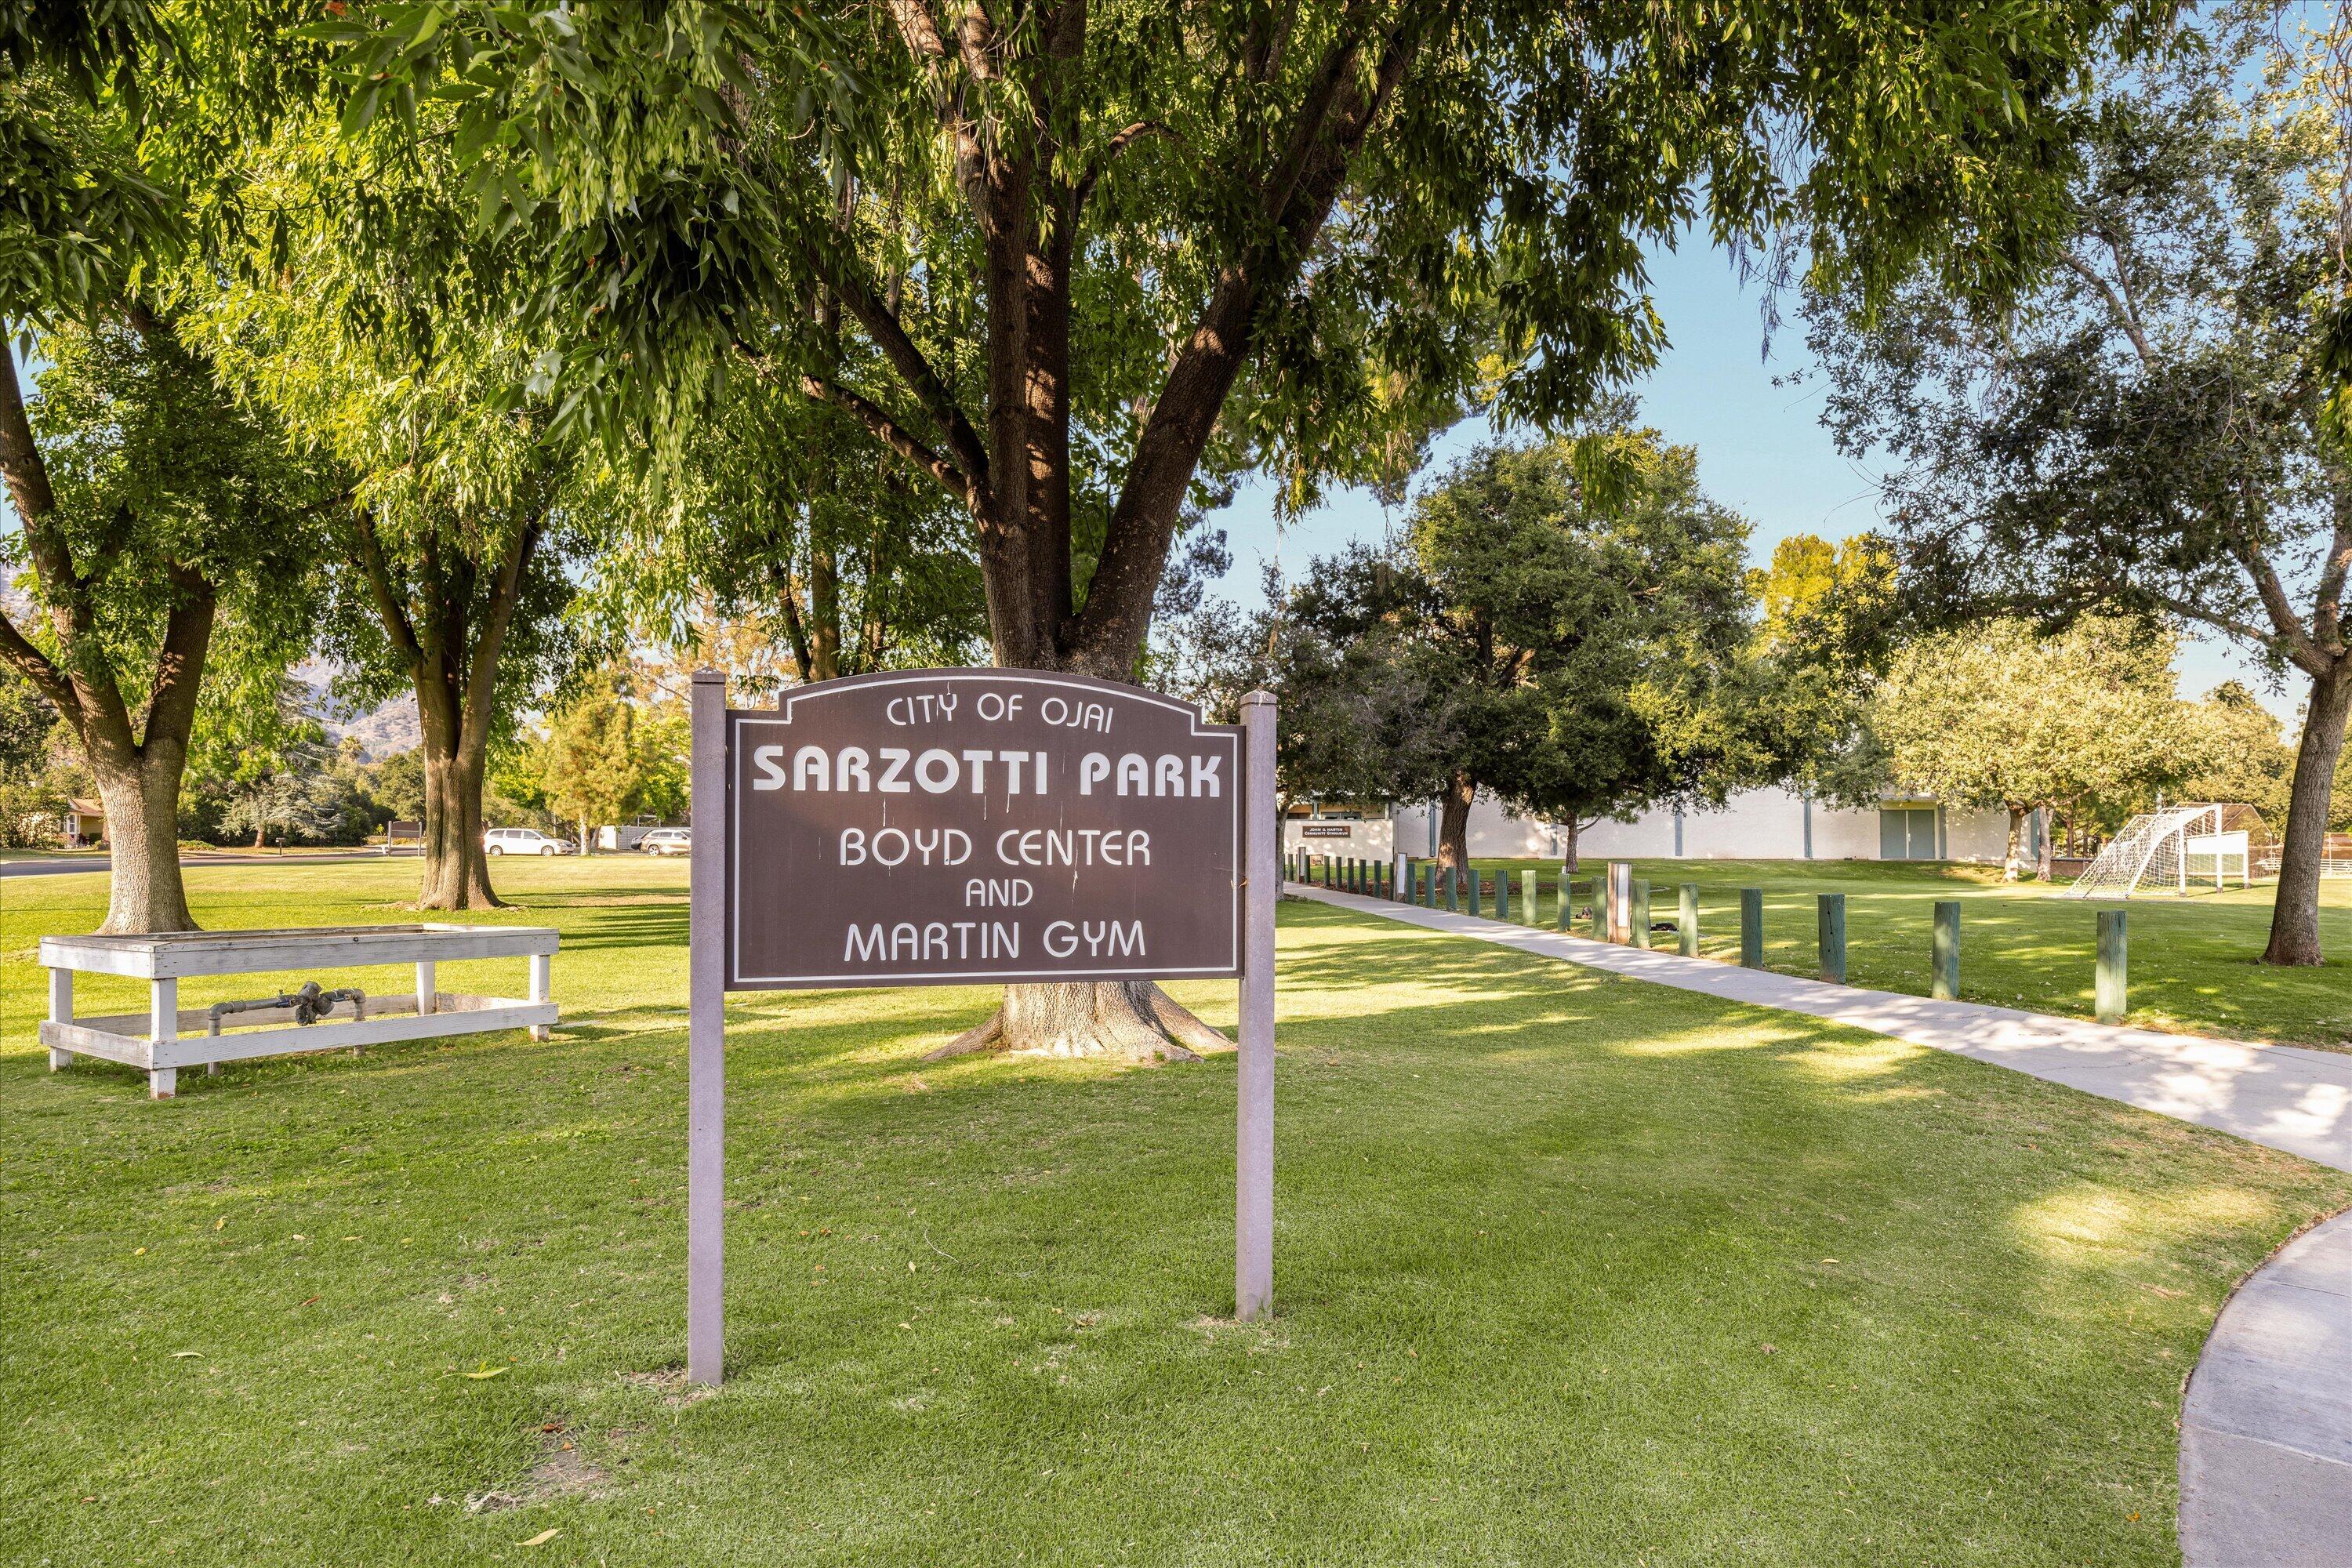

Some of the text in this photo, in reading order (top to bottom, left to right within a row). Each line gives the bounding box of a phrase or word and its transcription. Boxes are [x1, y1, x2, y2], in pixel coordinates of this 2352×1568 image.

[886, 692, 1114, 734] CITY OF OJAI
[753, 745, 1222, 797] SARZOTTI PARK
[840, 827, 1150, 866] BOYD CENTER
[965, 878, 1033, 907] AND
[844, 920, 1146, 962] MARTIN GYM
